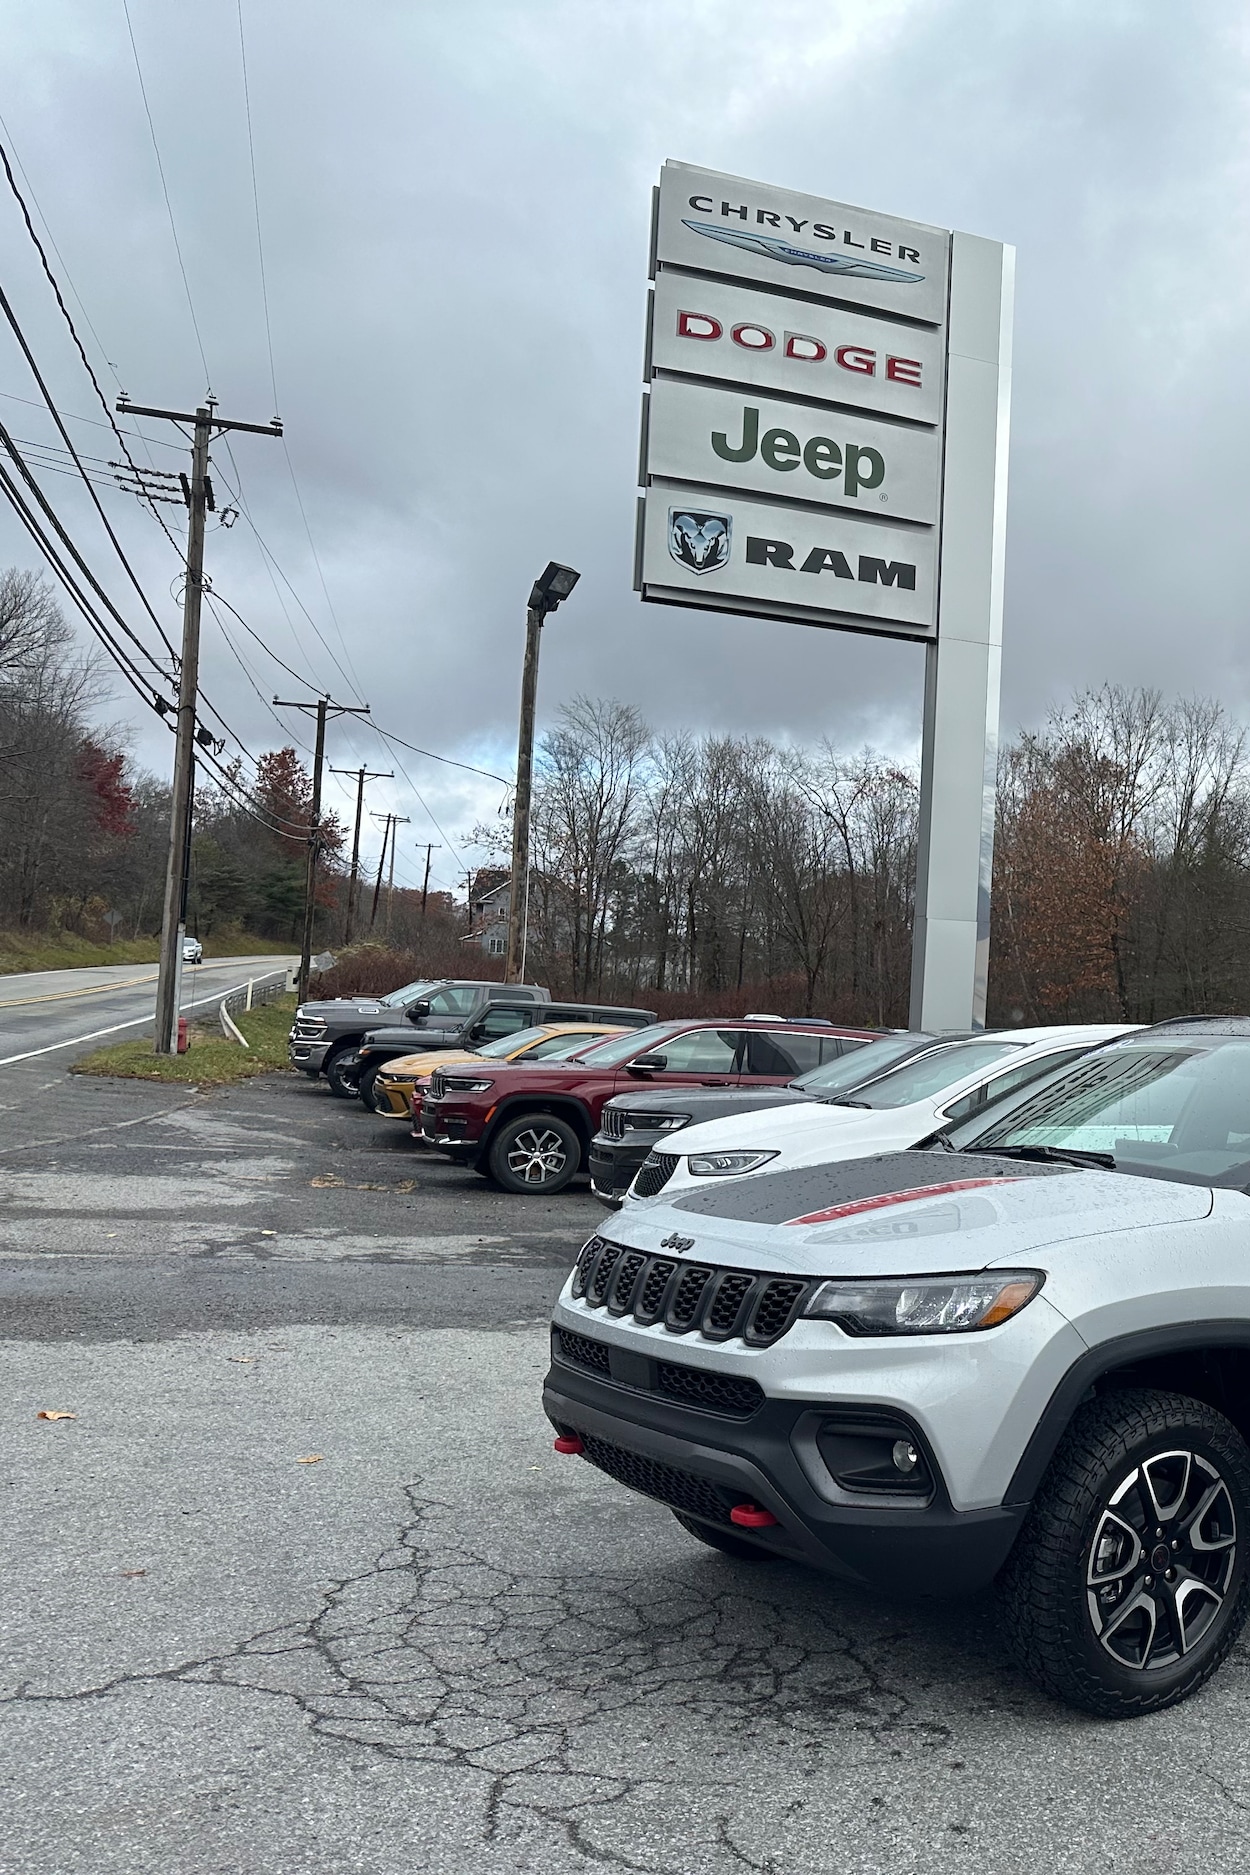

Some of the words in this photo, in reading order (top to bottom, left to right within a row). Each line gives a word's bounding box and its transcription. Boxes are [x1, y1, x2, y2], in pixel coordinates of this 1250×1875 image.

[688, 195, 921, 264] CHRYSLER
[676, 309, 923, 389] DODGE
[711, 406, 886, 498] Jeep
[746, 535, 917, 591] RAM
[660, 1232, 695, 1254] Jeep
